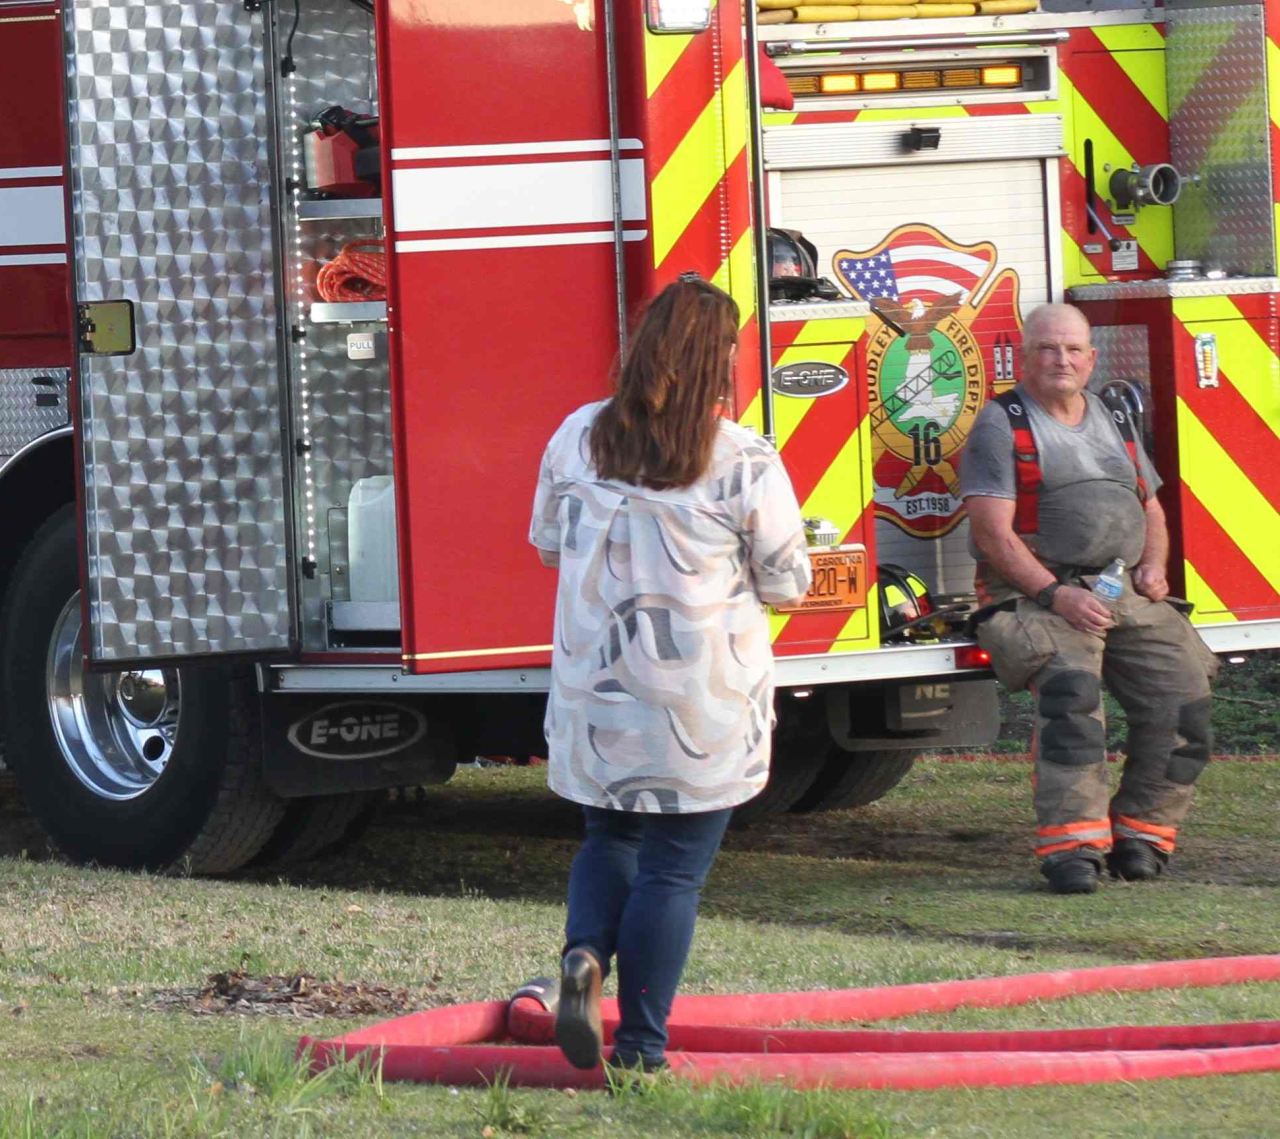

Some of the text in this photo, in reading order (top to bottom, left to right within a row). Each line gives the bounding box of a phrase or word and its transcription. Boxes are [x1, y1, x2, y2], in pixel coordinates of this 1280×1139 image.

[779, 368, 837, 388] E-ONE
[867, 326, 893, 402] DUDLEY
[945, 320, 979, 415] FIRE DEPT.
[907, 421, 942, 467] 16
[310, 714, 399, 744] E-ONE
